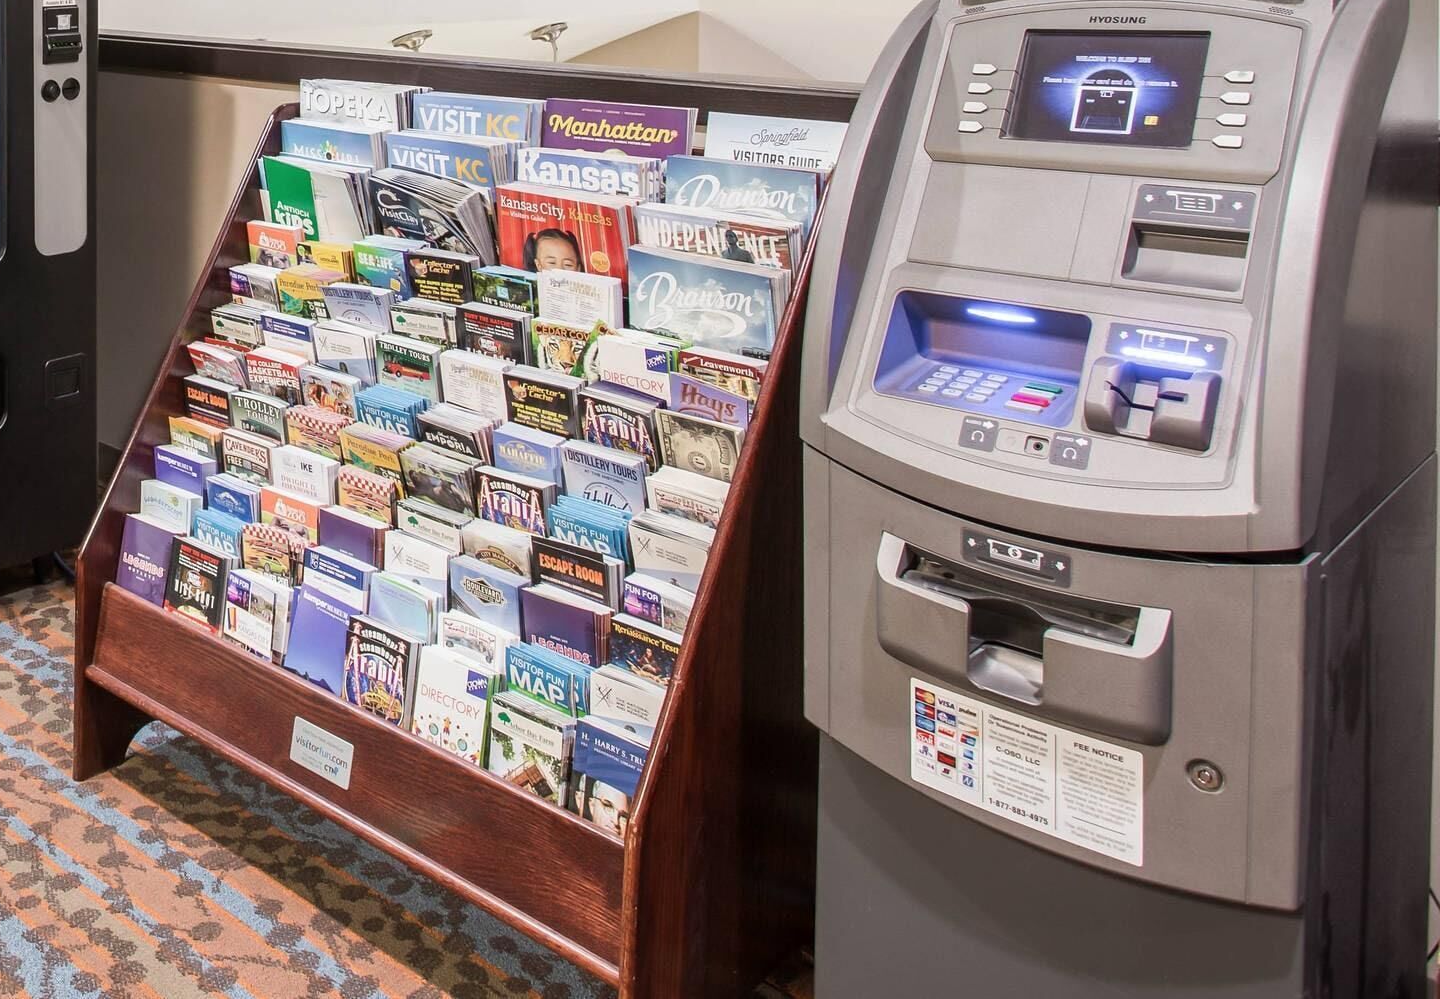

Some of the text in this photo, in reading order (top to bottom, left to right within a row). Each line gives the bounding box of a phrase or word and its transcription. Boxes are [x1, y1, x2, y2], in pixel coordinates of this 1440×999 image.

[1088, 15, 1147, 25] HYOSUNG
[303, 85, 393, 123] TOPEKA
[419, 106, 520, 139] VISIT KC
[548, 113, 677, 144] Manhattan
[392, 147, 488, 184] VISIT KC
[732, 148, 785, 165] VISITORS
[517, 150, 641, 197] Kansas
[276, 201, 310, 218] ANTIOCH
[500, 195, 613, 227] Kansas City, Kansas
[509, 211, 547, 223] Visitors Guide
[482, 295, 527, 312] LEE'S SUMMIT
[535, 325, 590, 340] CEDAR COV
[379, 341, 431, 362] TROLLEY TOURS
[247, 366, 296, 379] BASKETBALL
[700, 358, 754, 378] Leavenworth
[603, 370, 665, 394] DIRECTORY
[235, 396, 281, 419] TROLLEY
[364, 406, 408, 425] VISITOR FUN
[225, 438, 266, 464] CAVENDER'S
[426, 431, 473, 455] EMPORIA
[226, 455, 243, 466] FREE
[301, 462, 313, 472] IKE
[567, 449, 638, 481] DISTILLERY TOURS
[552, 517, 609, 543] VISITOR FUN
[538, 553, 603, 586] ESCAPE ROOM
[465, 579, 502, 604] BOULEVARD
[624, 583, 659, 602] FUN FOR
[531, 634, 591, 665] LEGENDS
[509, 655, 565, 688] VISITOR FUN
[509, 666, 565, 705] MAP
[421, 684, 480, 720] DIRECTORY
[938, 698, 955, 710] VISA
[296, 735, 347, 769] visitorfun.com
[594, 738, 619, 754] HARRY
[1074, 742, 1124, 763] FEE NOTICE
[1025, 755, 1040, 766] LLC
